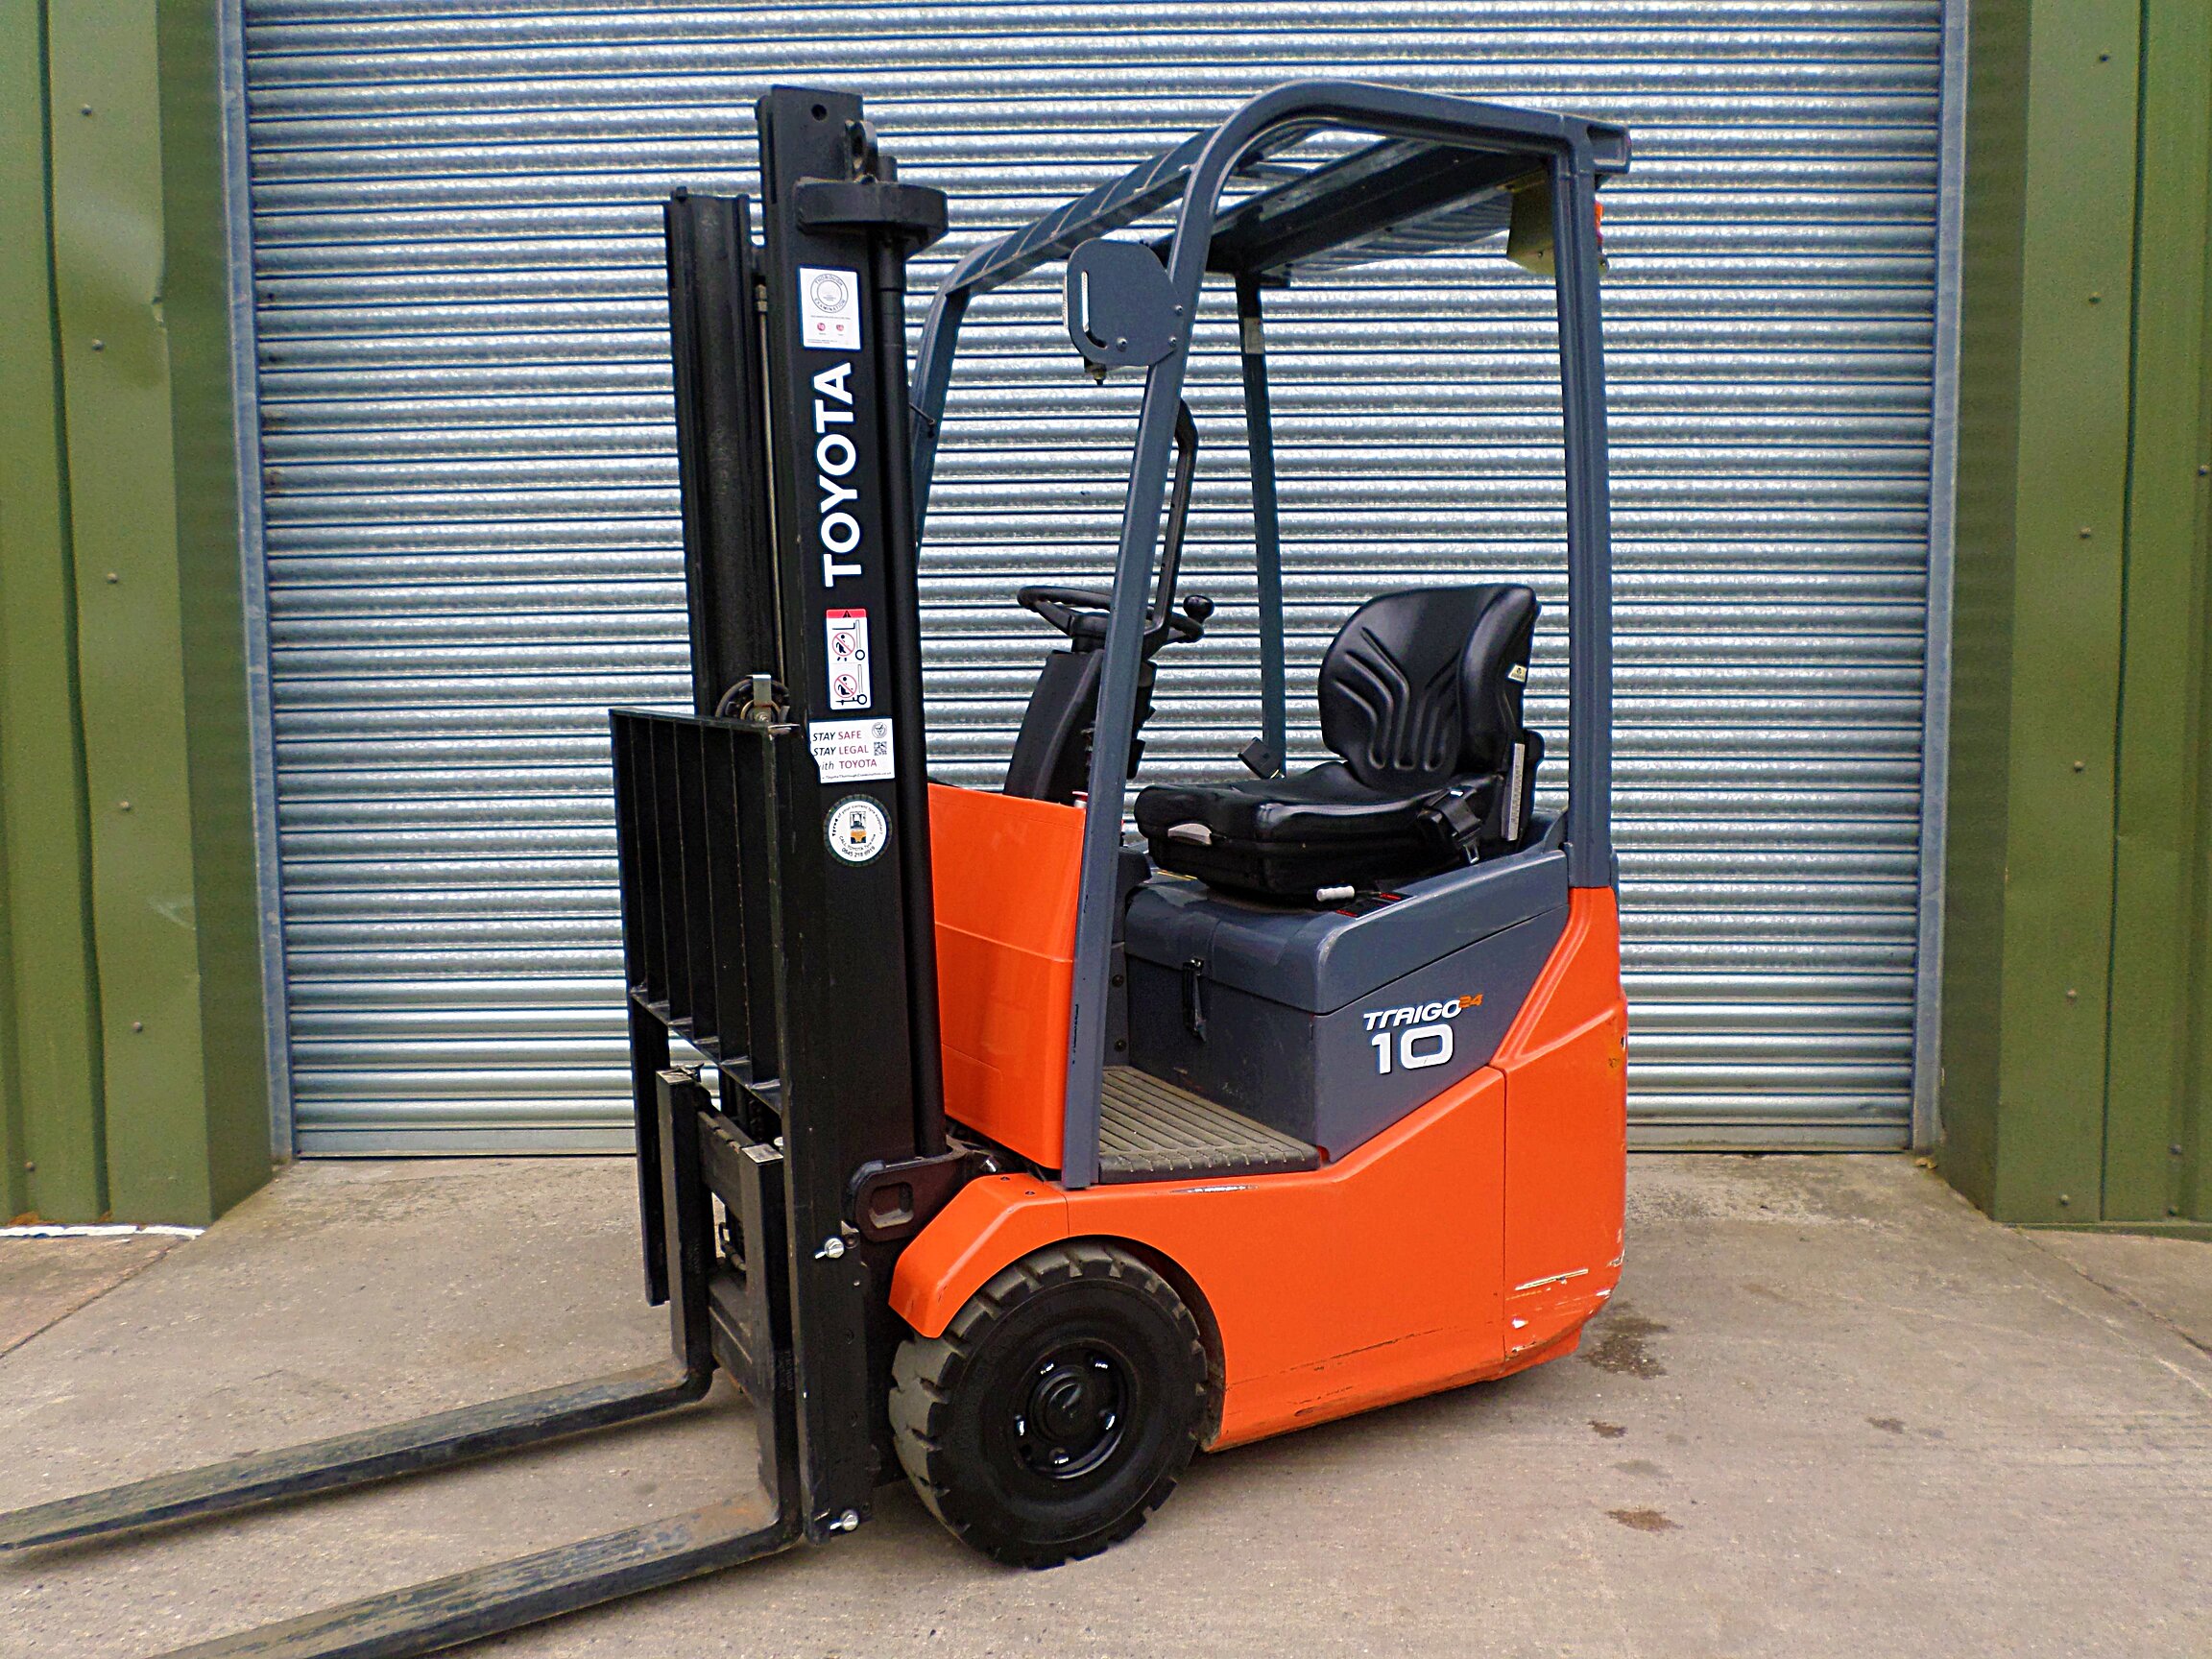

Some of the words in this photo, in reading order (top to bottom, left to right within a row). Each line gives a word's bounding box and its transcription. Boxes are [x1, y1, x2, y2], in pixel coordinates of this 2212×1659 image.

[813, 362, 862, 588] TOYOTA
[812, 732, 836, 742] STAY
[838, 730, 862, 740] SAFE
[813, 747, 836, 757] STAY
[838, 745, 869, 756] LEGAL
[819, 760, 834, 770] ith
[839, 758, 878, 769] TOYOTA
[1362, 999, 1462, 1031] TRAIGO
[1371, 1023, 1454, 1074] 10
